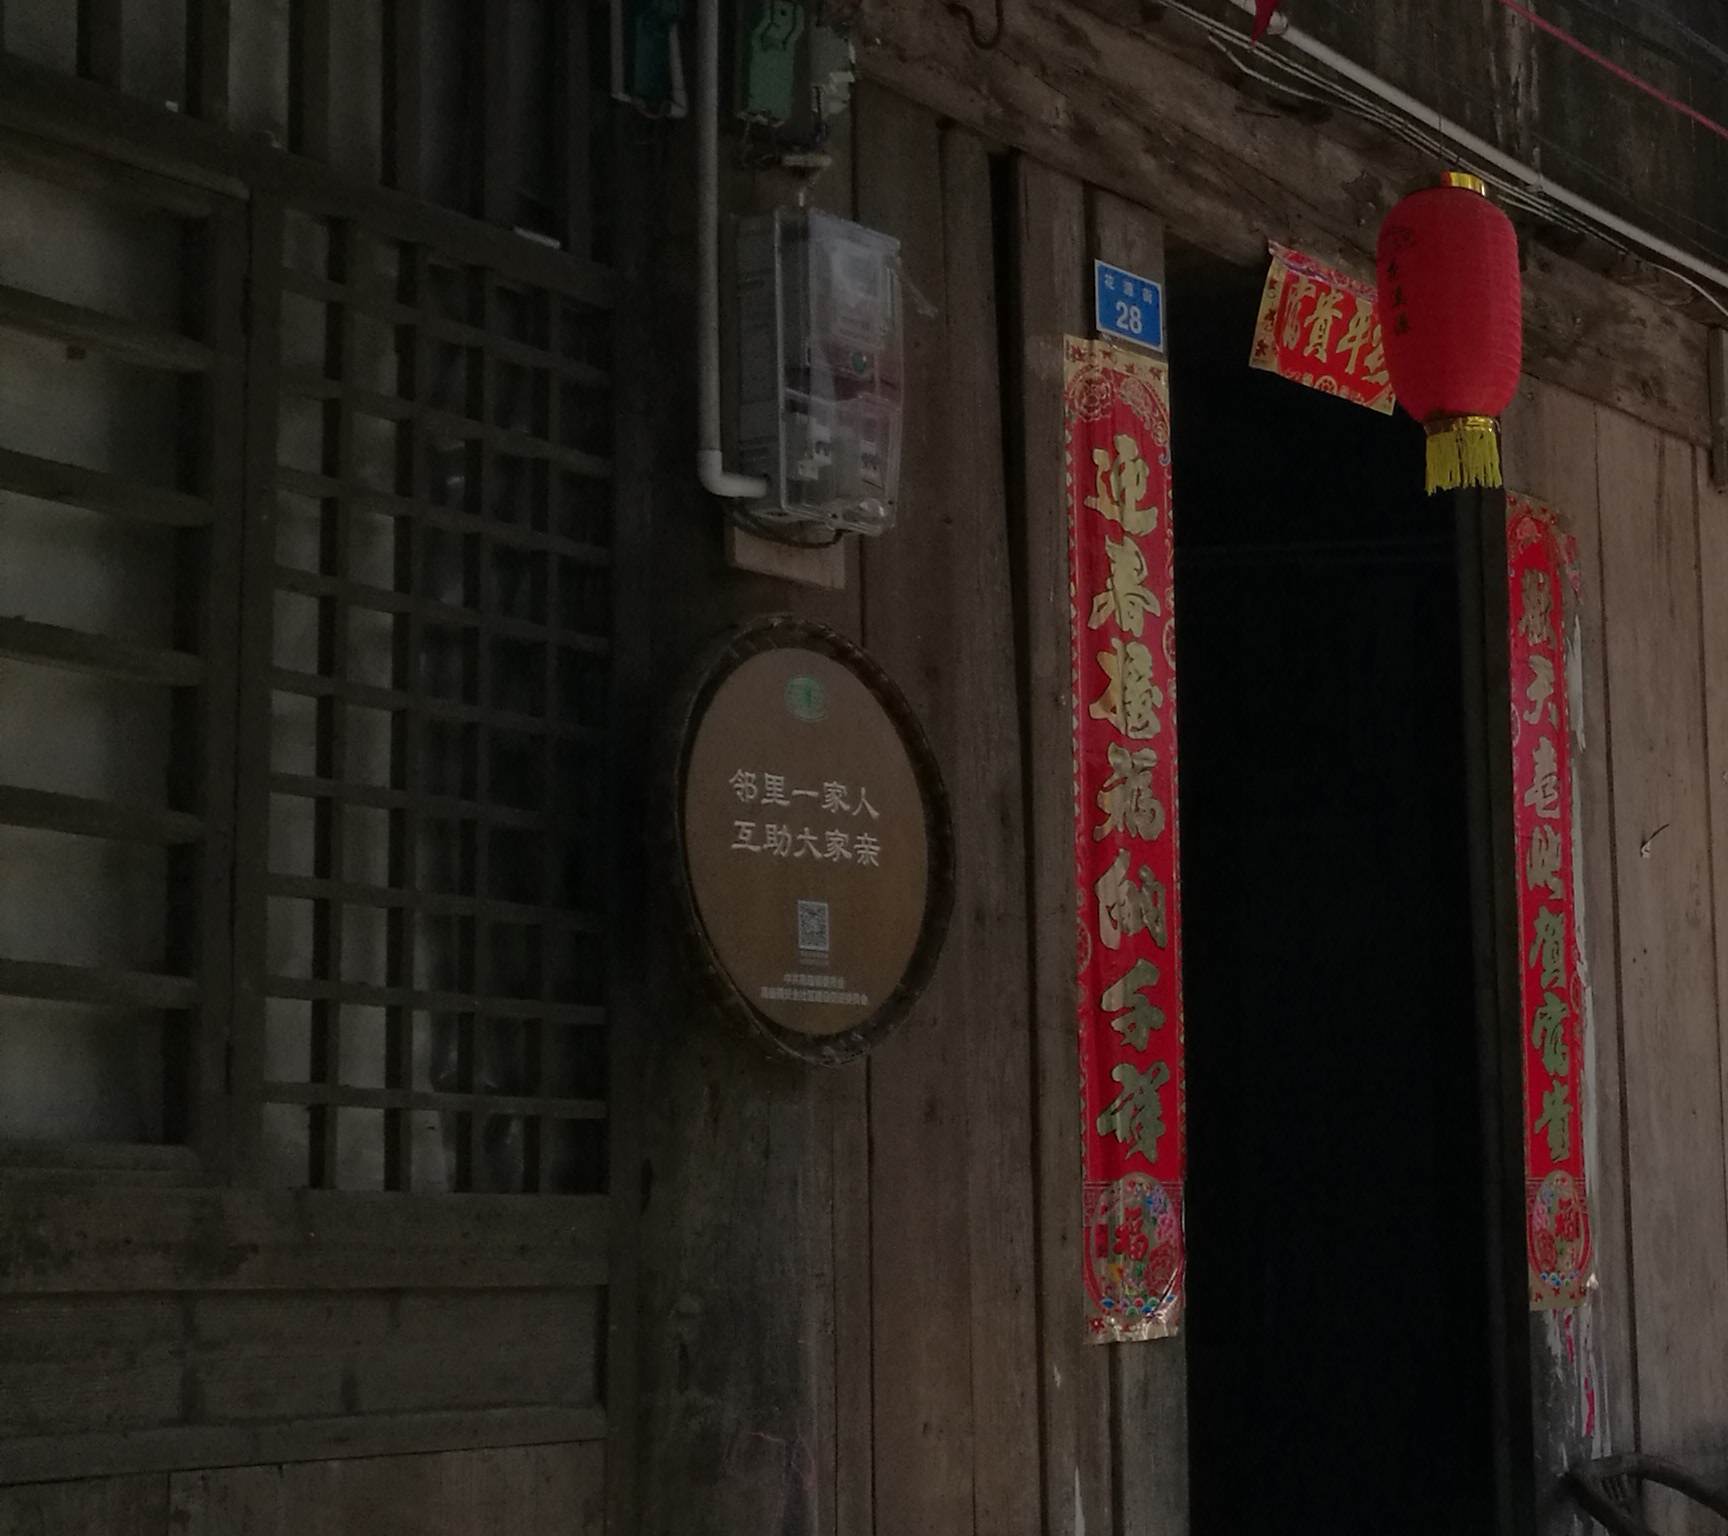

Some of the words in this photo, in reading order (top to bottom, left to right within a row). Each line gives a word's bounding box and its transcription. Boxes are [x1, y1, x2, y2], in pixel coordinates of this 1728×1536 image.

[1116, 301, 1142, 334] 28
[729, 768, 880, 819] 邻里一家人
[731, 820, 880, 867] 互助大家亲
